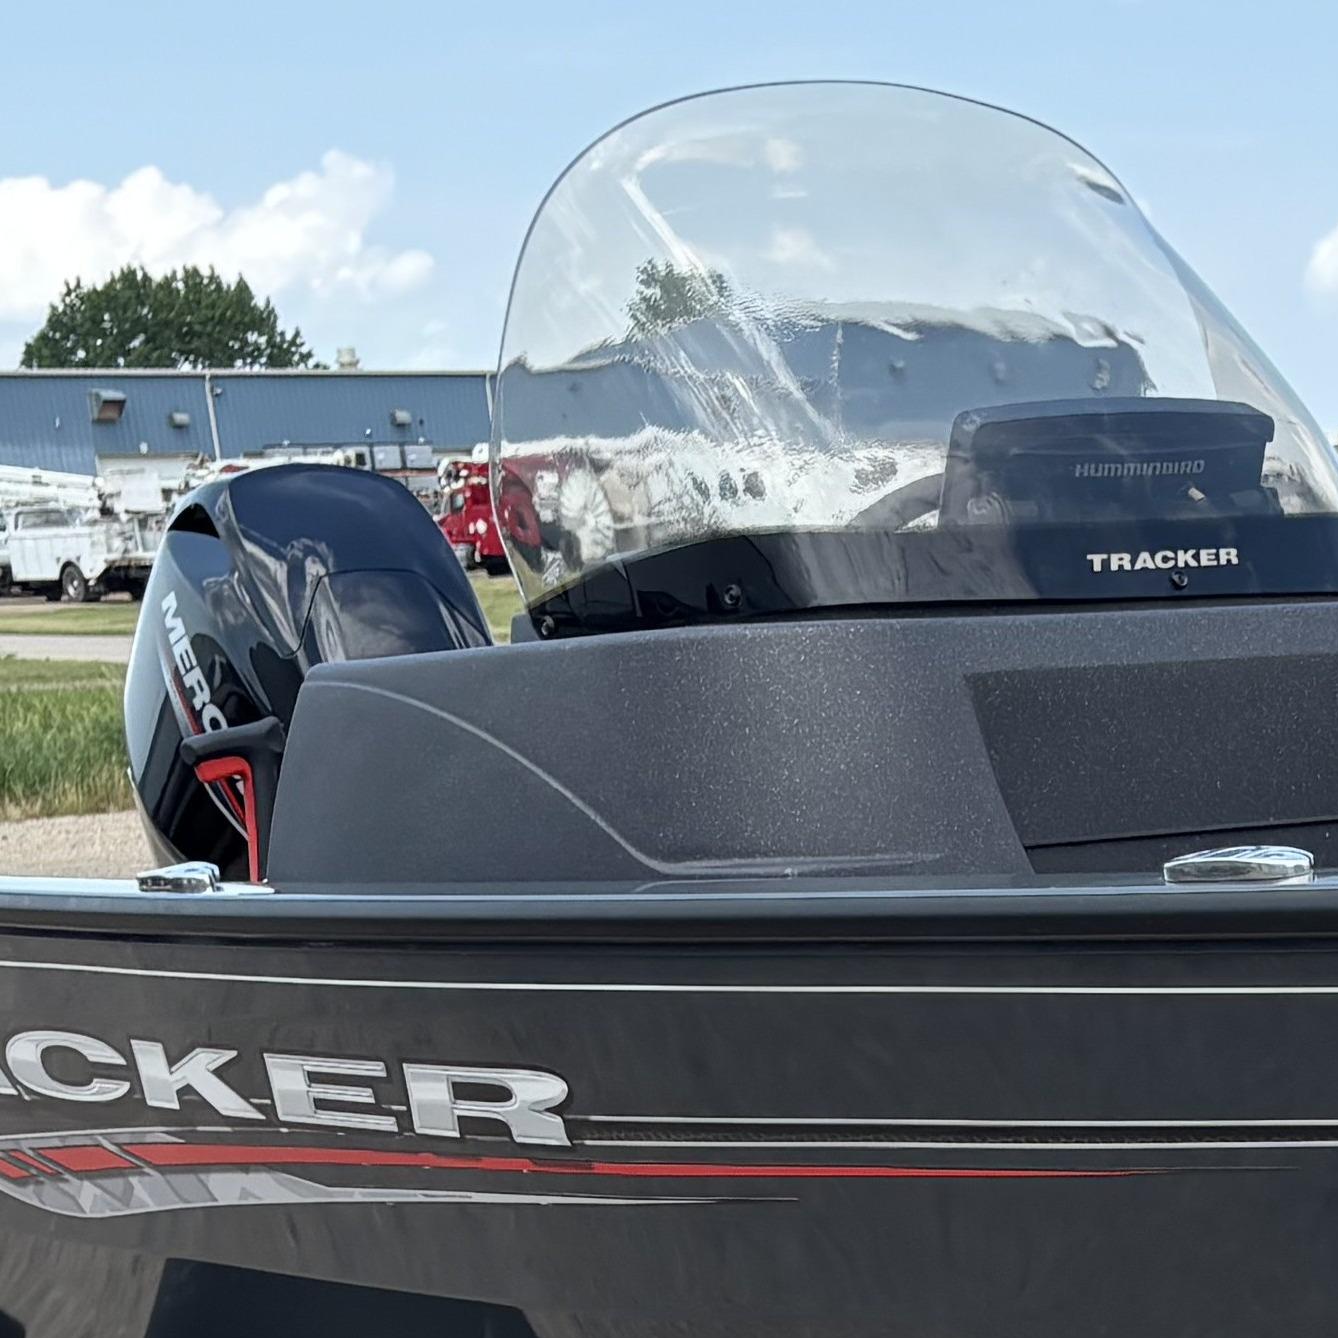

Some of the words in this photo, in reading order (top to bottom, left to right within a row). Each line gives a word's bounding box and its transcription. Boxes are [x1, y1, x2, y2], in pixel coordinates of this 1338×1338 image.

[1075, 459, 1205, 478] HUMMINBIRD
[1086, 547, 1239, 572] TRACKER
[161, 591, 229, 734] MERC
[0, 1030, 572, 1147] CKER
